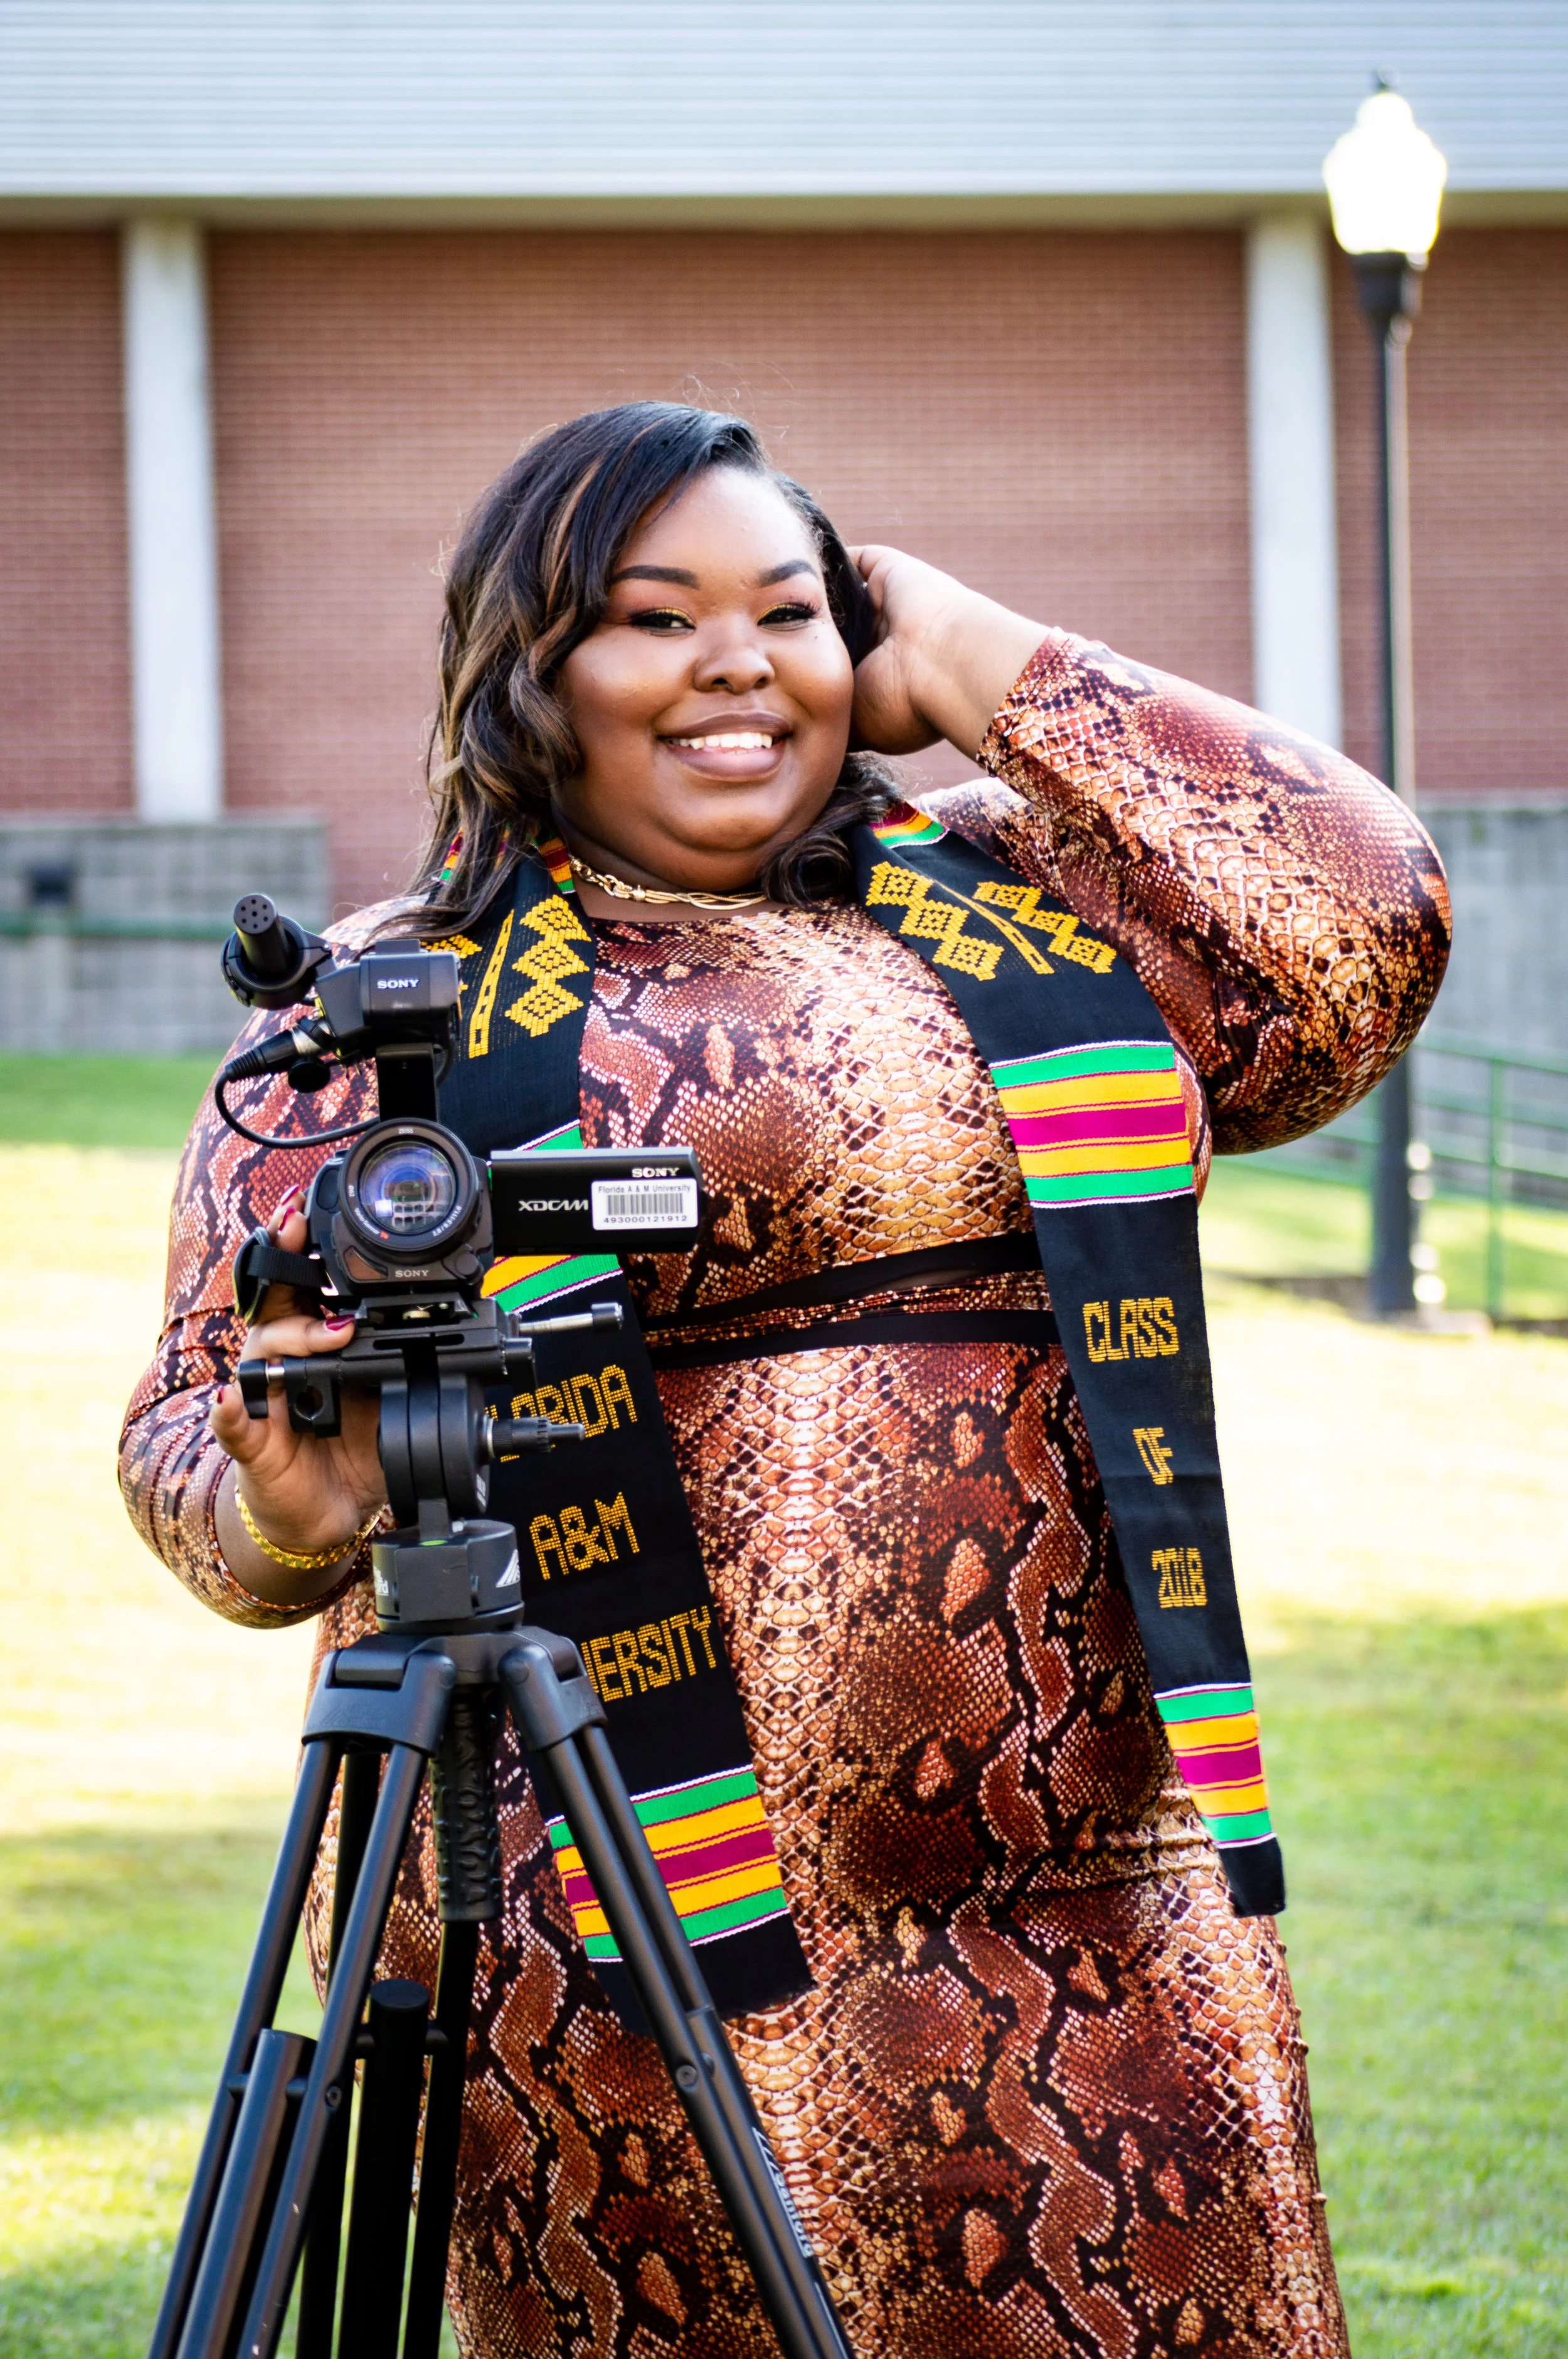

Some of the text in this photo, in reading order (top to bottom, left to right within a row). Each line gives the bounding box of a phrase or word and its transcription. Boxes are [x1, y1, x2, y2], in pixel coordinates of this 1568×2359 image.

[377, 979, 420, 989] SONY
[632, 1167, 679, 1178] SONY
[653, 1184, 691, 1193] University
[519, 1200, 588, 1211] XDCAM
[603, 1215, 687, 1223] 493000121912
[1083, 1297, 1180, 1363] CLASS
[485, 1365, 638, 1462] ORIDA
[1133, 1427, 1174, 1486] OF
[529, 1491, 640, 1580] A&M
[1152, 1547, 1208, 1609] 2018
[581, 1605, 718, 1702] ERSITY
